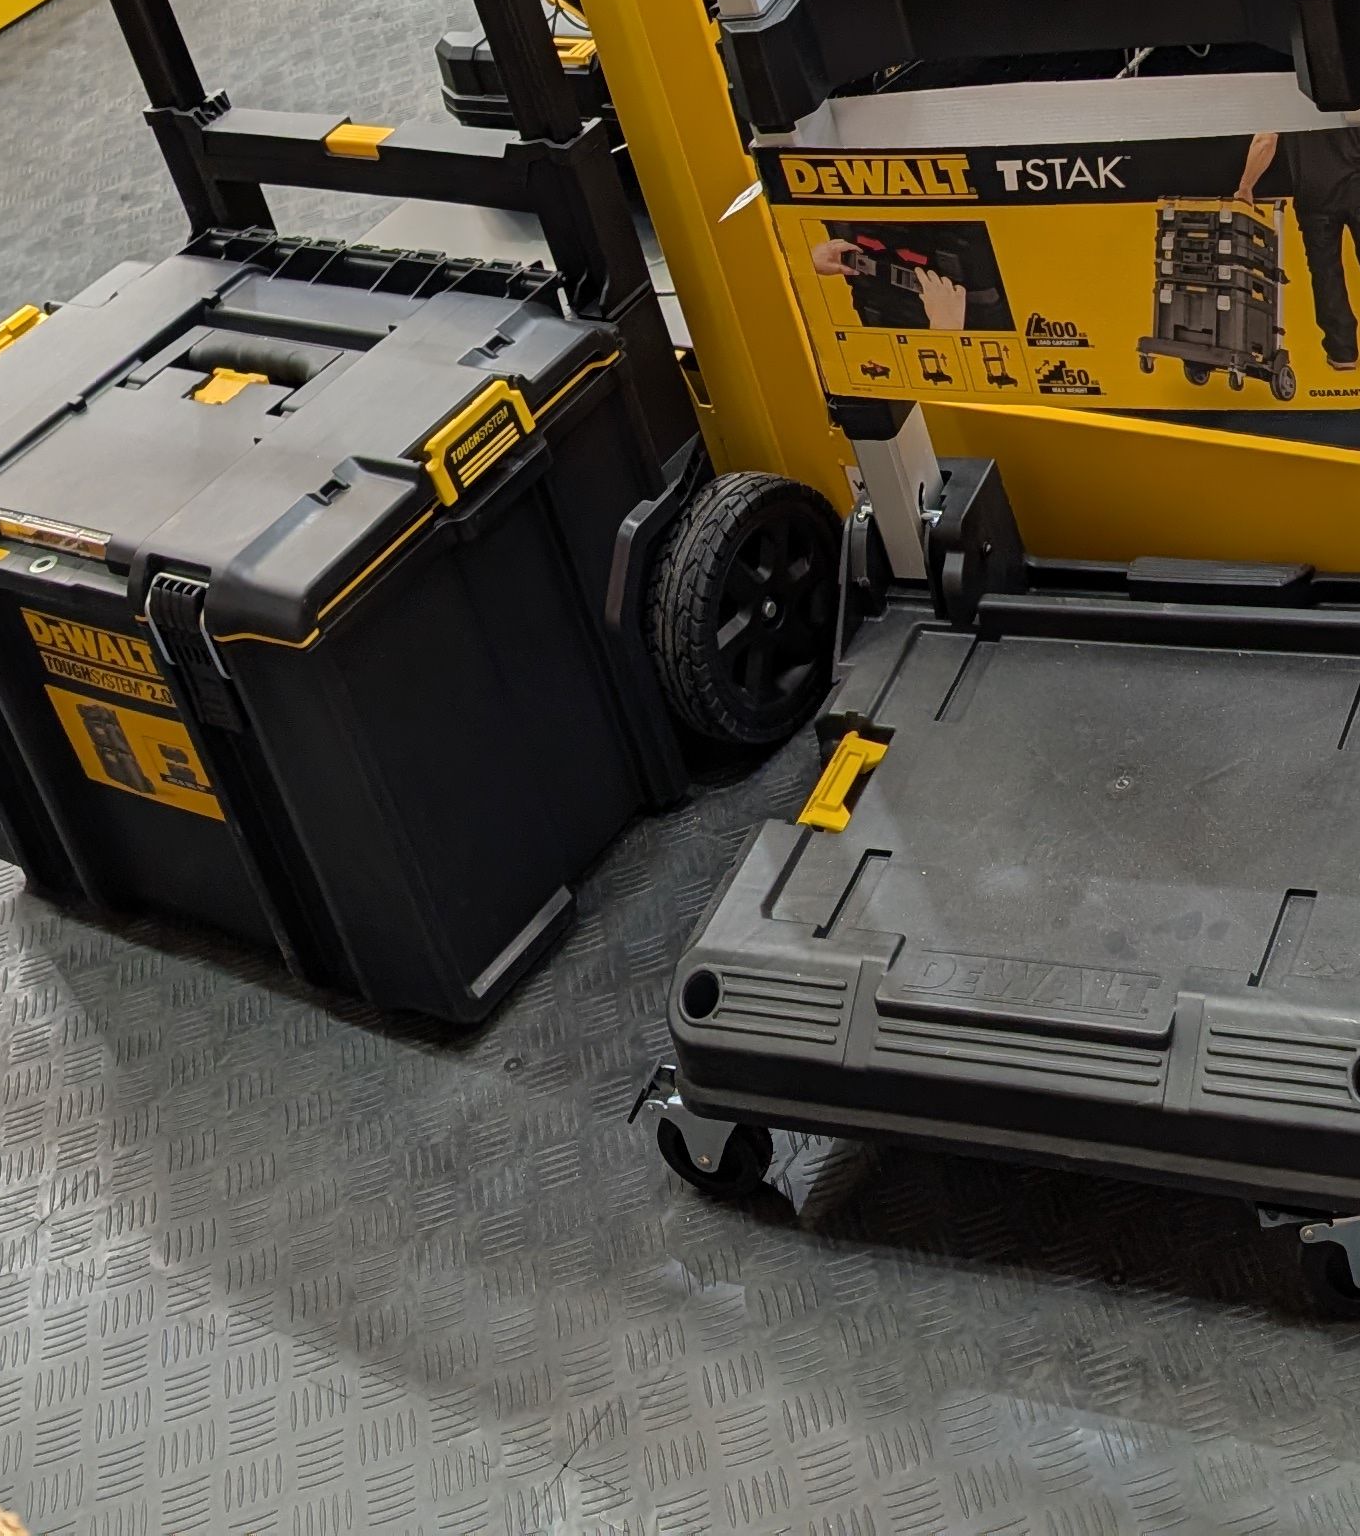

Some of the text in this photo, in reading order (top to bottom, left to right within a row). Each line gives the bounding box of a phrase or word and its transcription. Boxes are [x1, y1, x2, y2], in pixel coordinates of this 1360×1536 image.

[780, 154, 1127, 200] DEWALT TSTAK
[1042, 321, 1078, 338] 100
[1064, 369, 1090, 386] 50
[449, 404, 510, 466] TOUGHSYSTEM
[20, 606, 165, 682] DEWALT
[43, 654, 173, 705] TOUGHSYSTEM 2.0
[898, 948, 1159, 1020] DEWALT
